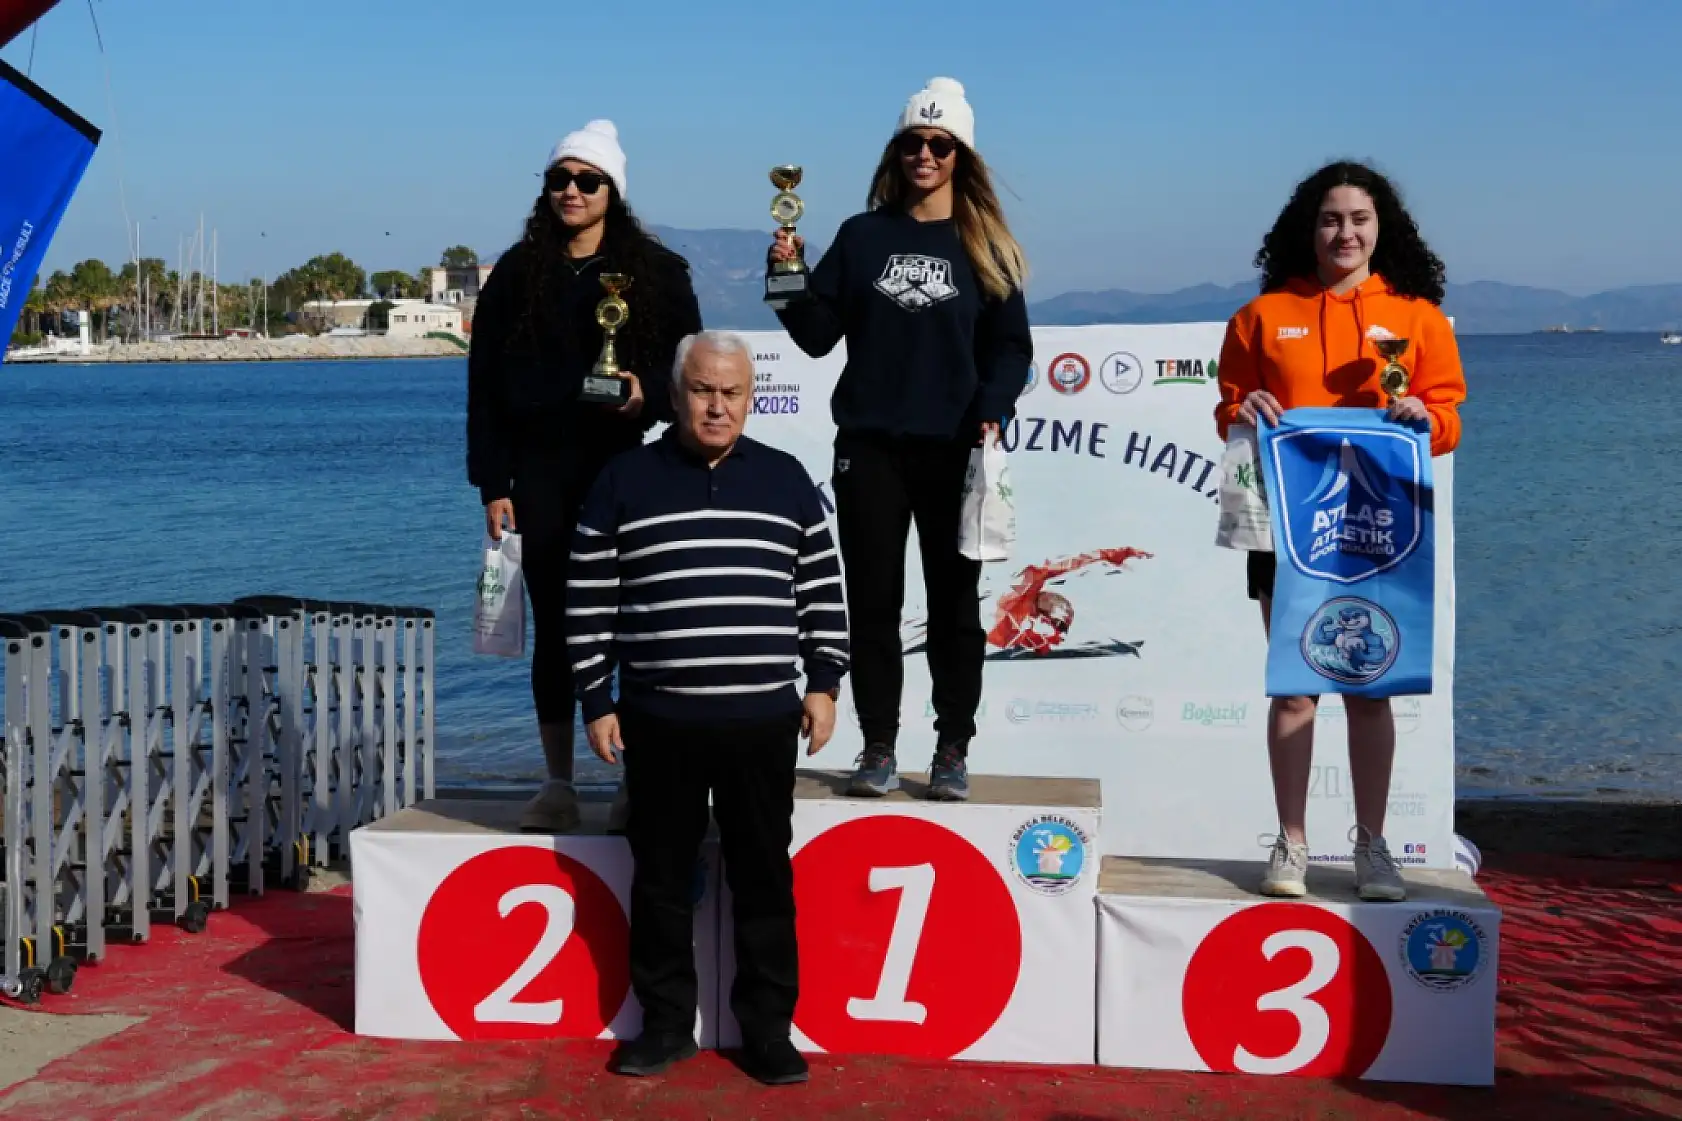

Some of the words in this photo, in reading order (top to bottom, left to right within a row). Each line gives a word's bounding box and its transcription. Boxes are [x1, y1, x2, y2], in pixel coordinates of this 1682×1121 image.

[890, 266, 945, 284] arena
[753, 352, 781, 362] RASI
[1155, 359, 1204, 377] TEMA
[747, 396, 799, 414] K2026
[1312, 502, 1394, 534] ATLAS
[1311, 526, 1393, 552] ATLETİK
[473, 883, 576, 1026] 2
[845, 863, 936, 1027] 1
[1232, 929, 1341, 1076] 3
